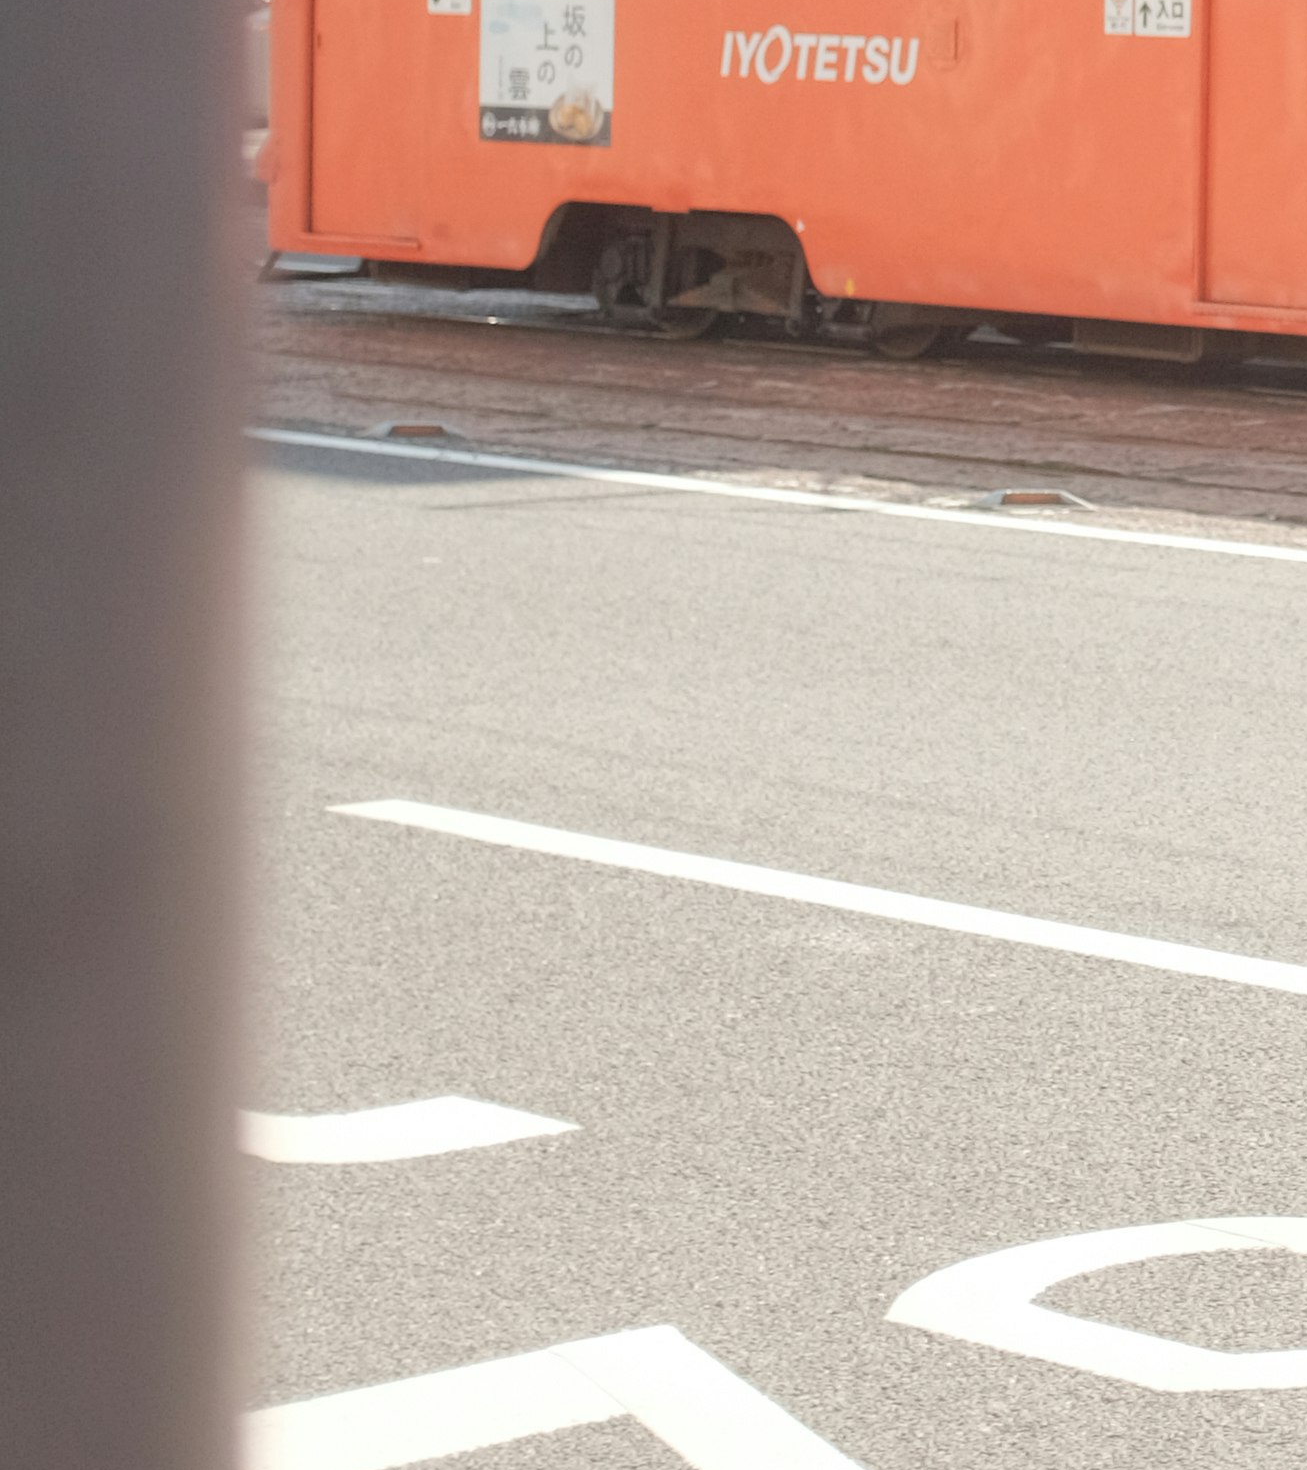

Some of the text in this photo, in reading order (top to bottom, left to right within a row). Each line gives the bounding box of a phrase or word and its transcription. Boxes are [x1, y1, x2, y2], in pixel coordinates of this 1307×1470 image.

[563, 4, 586, 69] 坂の
[1156, 0, 1184, 19] 入口
[536, 20, 560, 85] 上の
[721, 24, 920, 85] IYOTETSU
[508, 67, 531, 101] 雲
